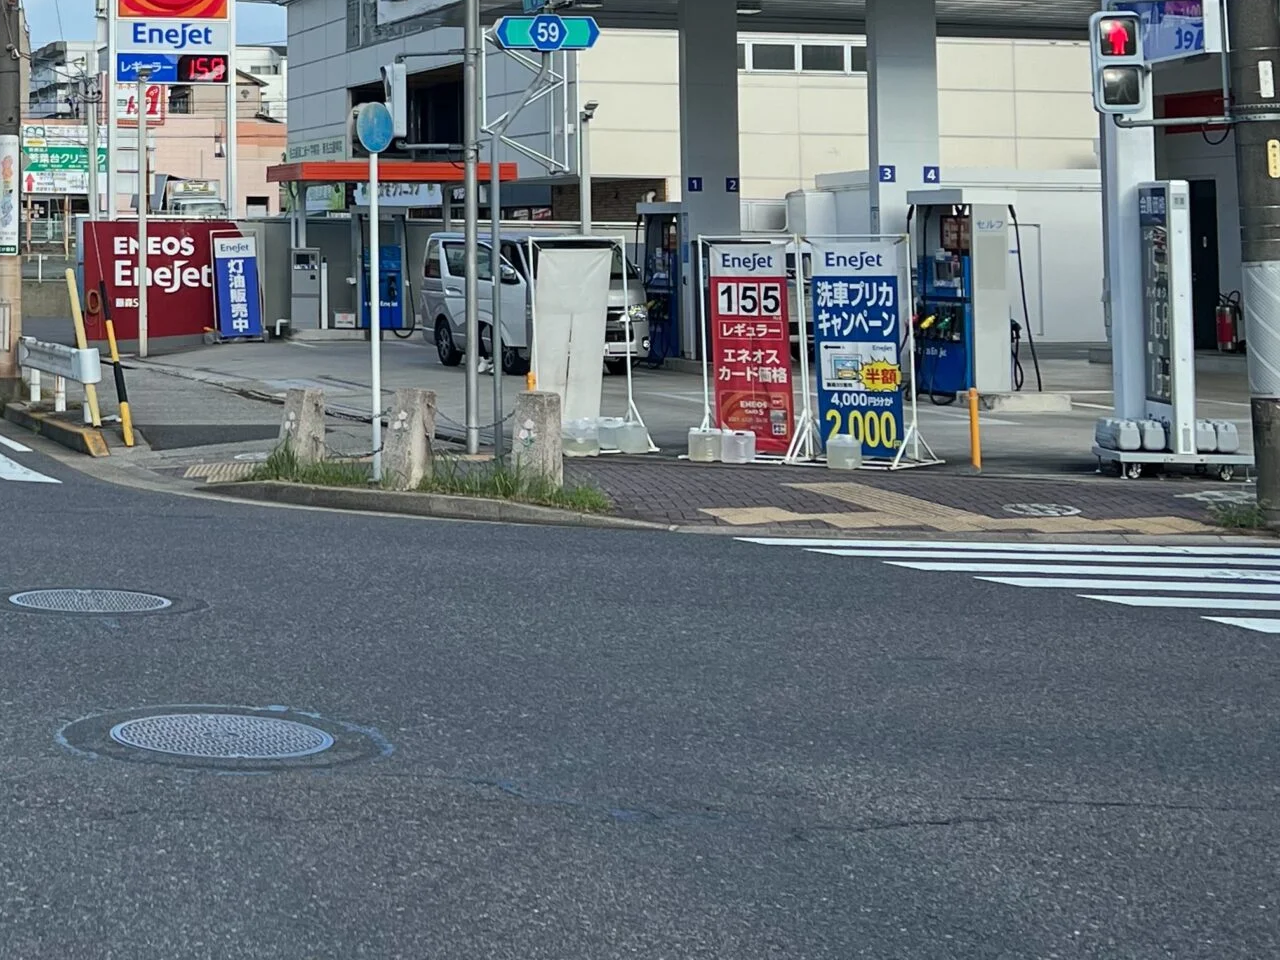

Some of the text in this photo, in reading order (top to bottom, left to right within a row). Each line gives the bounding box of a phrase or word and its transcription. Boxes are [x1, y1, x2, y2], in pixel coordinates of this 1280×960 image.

[536, 22, 560, 42] 59
[29, 153, 106, 164] 若葉台クリニク
[883, 167, 892, 180] 3
[926, 169, 936, 181] 4
[691, 179, 698, 190] 1
[729, 180, 736, 190] 2
[976, 220, 1004, 229] セルフ
[113, 236, 195, 256] ENEOS
[227, 258, 249, 333] 灯油販売中
[720, 284, 780, 313] 155
[816, 280, 894, 308] 洗車プリカ
[722, 323, 781, 337] レギュラー
[818, 308, 896, 337] キャンペーン
[723, 348, 780, 364] エネオス
[718, 365, 788, 383] カード価格
[865, 367, 897, 385] 半額
